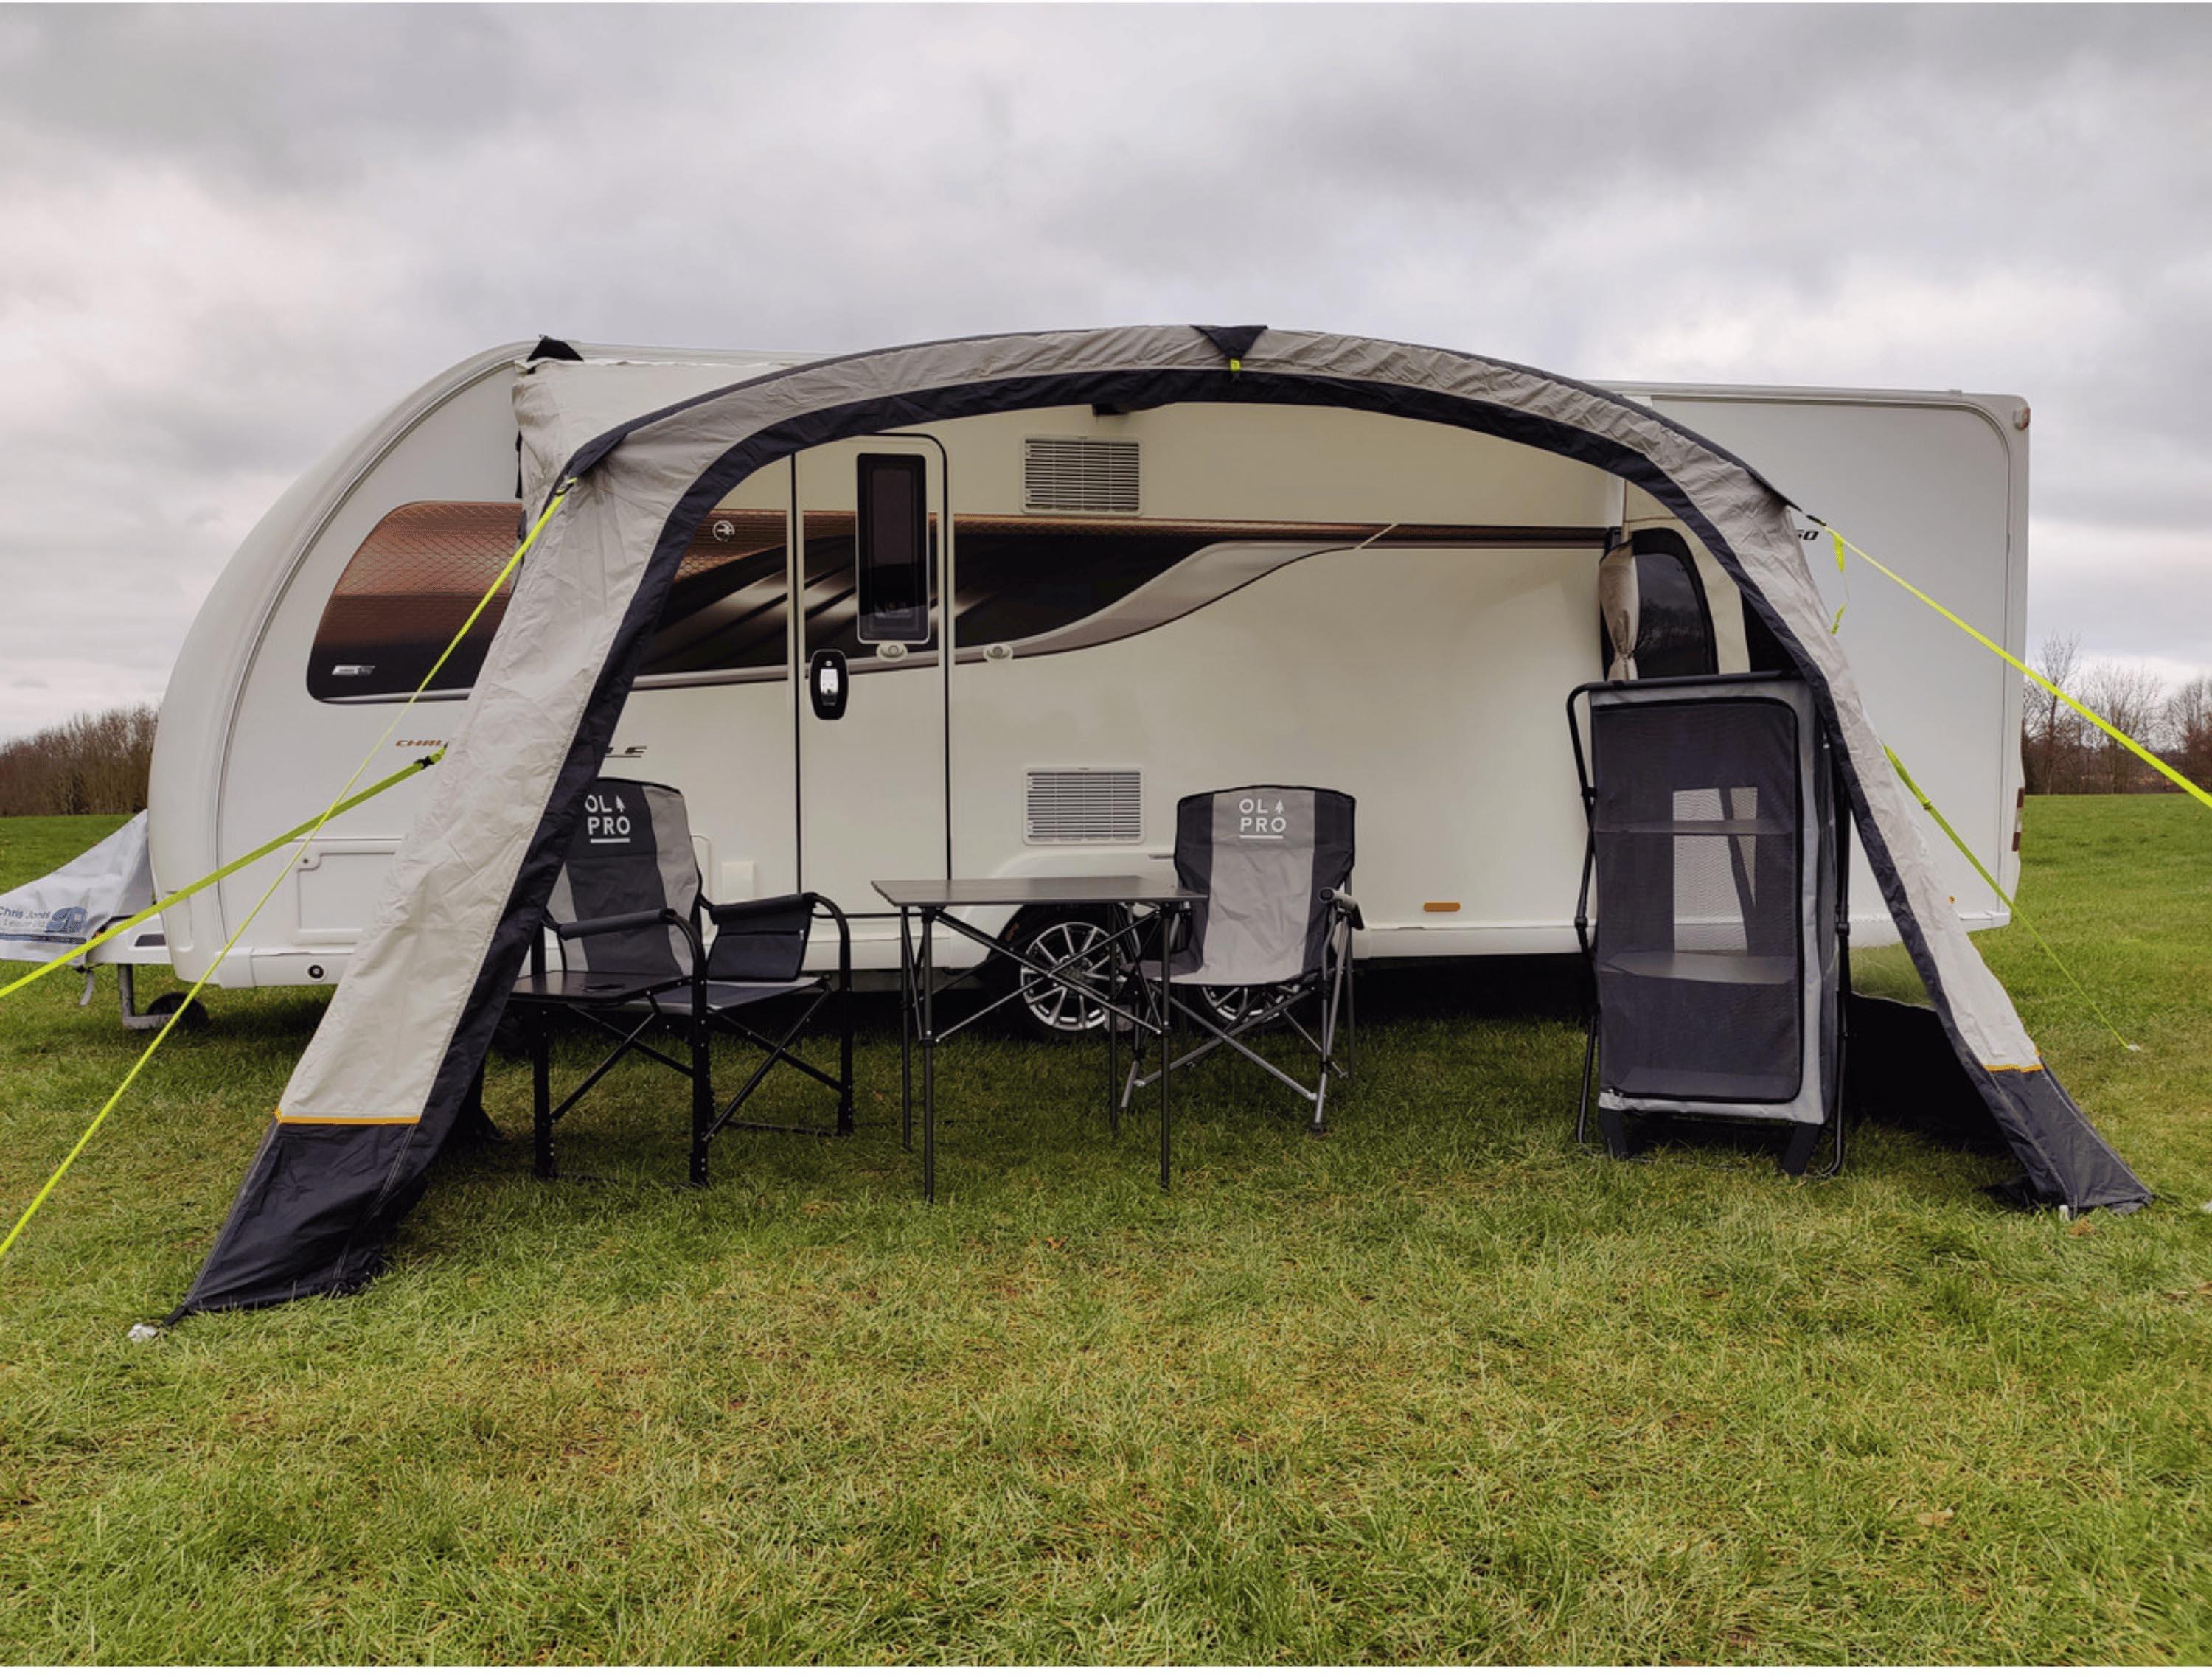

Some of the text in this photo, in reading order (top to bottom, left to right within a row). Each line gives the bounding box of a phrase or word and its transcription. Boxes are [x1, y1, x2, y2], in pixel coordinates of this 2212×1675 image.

[585, 794, 613, 813] OL
[1239, 798, 1269, 814] OL
[587, 815, 631, 835] PRO
[1240, 816, 1287, 832] PRO
